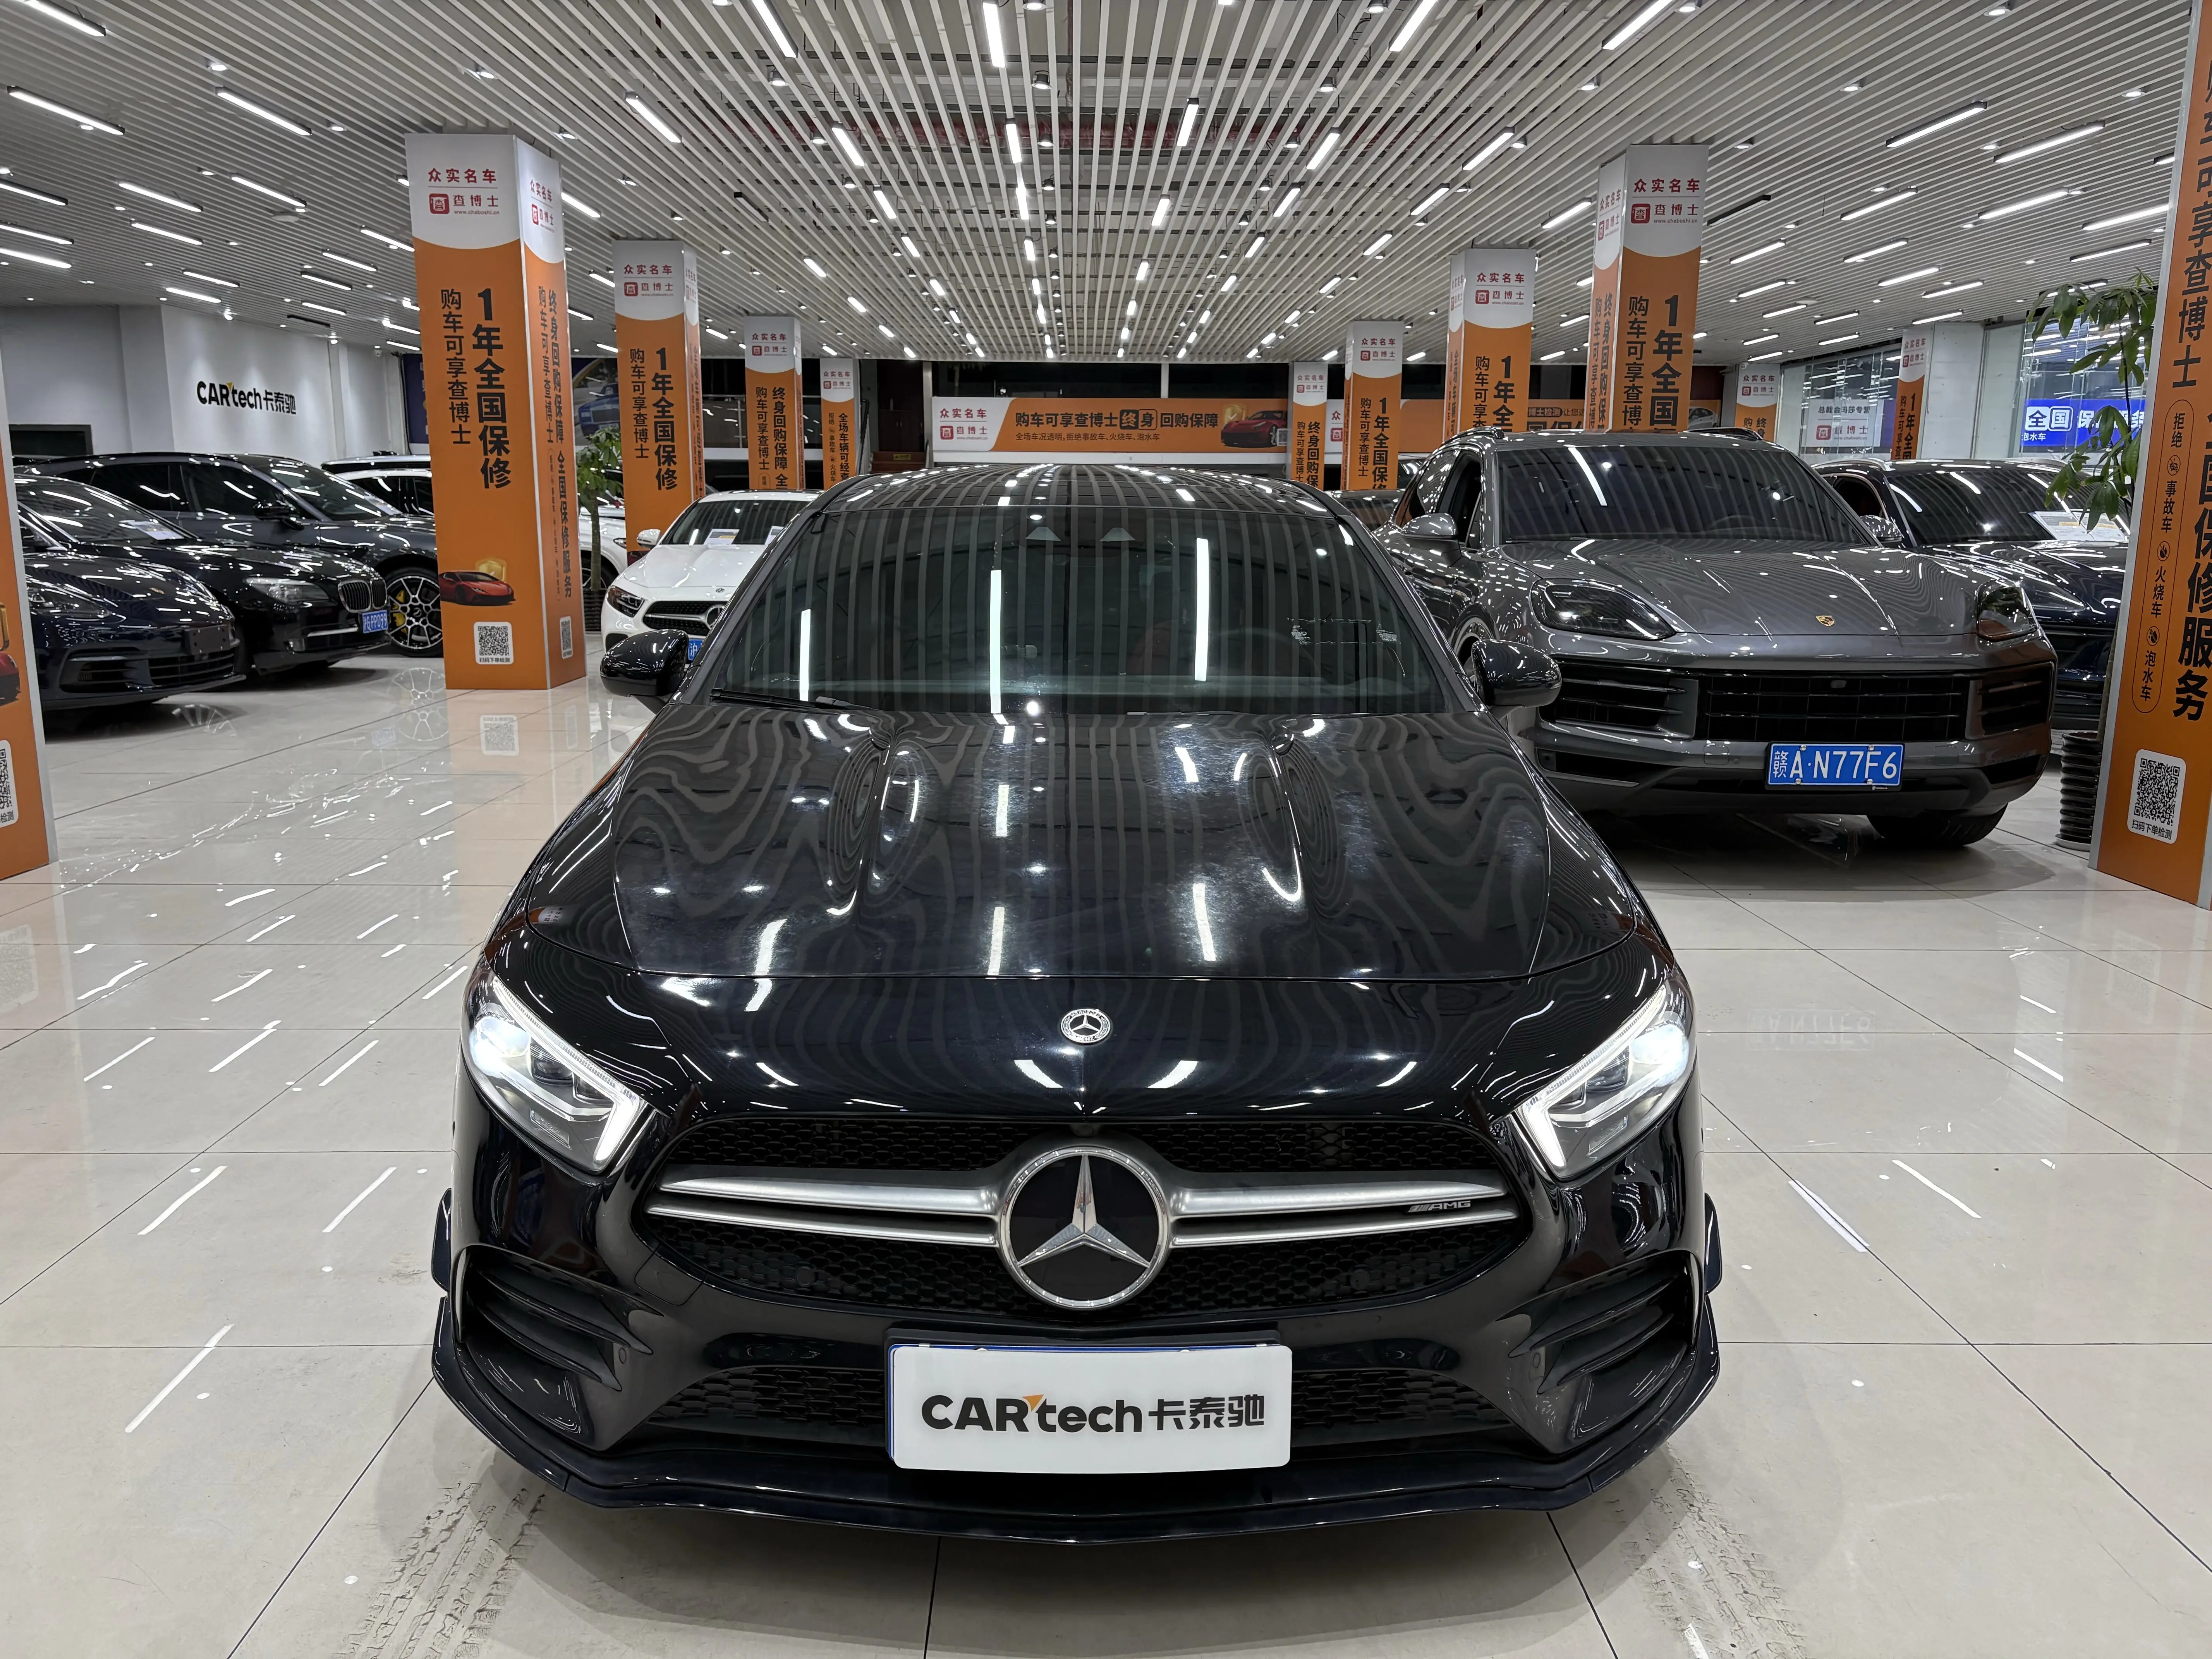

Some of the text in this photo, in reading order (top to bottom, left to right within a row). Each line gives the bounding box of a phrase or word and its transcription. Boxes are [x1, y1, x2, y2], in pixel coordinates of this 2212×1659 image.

[428, 168, 496, 184] 众实名车
[530, 179, 553, 203] 众实名车
[1633, 179, 1700, 192] 众实名车
[453, 194, 498, 207] 查博士
[1599, 189, 1621, 211] 众实名车
[1654, 204, 1698, 215] 查博士
[2172, 60, 2212, 388] 可享查博士
[624, 264, 672, 275] 众实名车
[641, 283, 673, 291] 查博士
[1477, 272, 1524, 283] 众实名车
[1492, 291, 1524, 299] 查博士
[1598, 292, 1613, 429] 终身回购保
[1905, 338, 1926, 348] 众实名车
[441, 289, 471, 444] 购车可享查博士
[539, 286, 553, 443] 购车可享查博士
[1622, 296, 1649, 430] 购车可享查博
[1649, 295, 1683, 431] 1年全国
[197, 381, 296, 414] CARtech 卡泰驰
[472, 288, 511, 489] 1年全国保修
[630, 348, 649, 459] 购车可享查博士
[1492, 356, 1515, 432] 1年全
[651, 347, 677, 491] 1年全国保修
[756, 386, 769, 470] 购车可享查博士
[773, 386, 788, 470] 终身回购保障
[940, 408, 987, 419] 众实名车
[957, 426, 988, 434] 查博士
[1895, 396, 1906, 459] 购车可享查
[549, 289, 564, 443] 终身回购保障
[558, 450, 571, 598] 全国保修服务
[1358, 398, 1371, 476] 购车可享查博士
[2140, 412, 2185, 701] 拒绝 事故车 火烧车 泡水车
[2132, 819, 2172, 840] 扫码下单检测
[1428, 1200, 1471, 1211] AMG
[921, 1394, 1265, 1432] CARtech 卡泰驰
